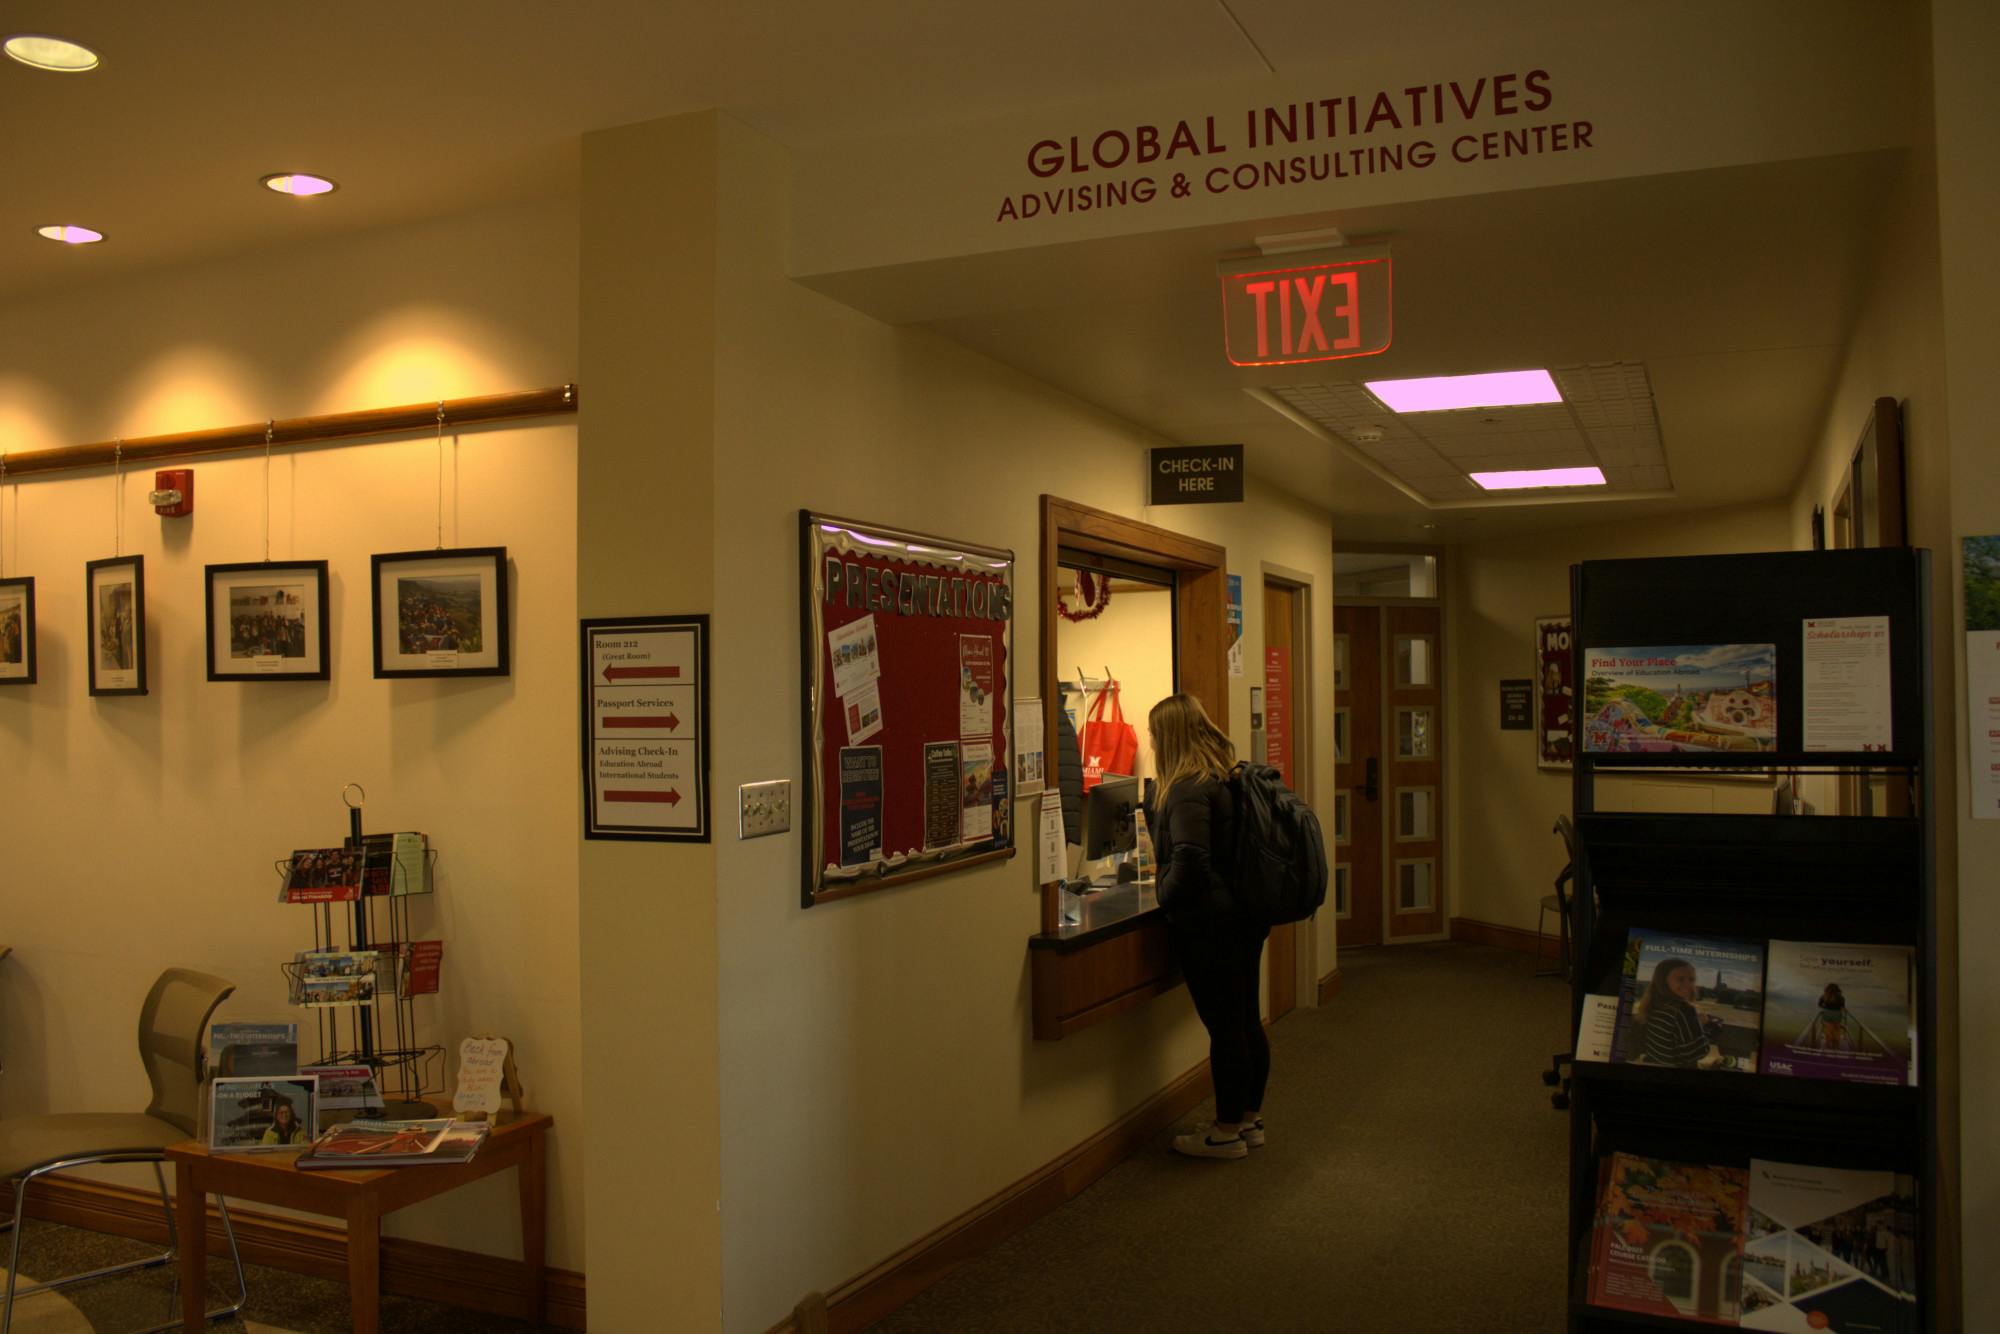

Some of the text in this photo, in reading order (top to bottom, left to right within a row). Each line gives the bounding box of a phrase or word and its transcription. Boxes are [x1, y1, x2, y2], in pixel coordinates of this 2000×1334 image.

[1028, 69, 1553, 179] GLOBAL INITIATIVES
[996, 120, 1595, 223] ADVISING & CONSULTING CENTER
[1159, 456, 1235, 474] CHECK-IN
[1178, 477, 1215, 493] HERE
[826, 556, 1012, 621] PRESENTATIONS
[595, 640, 622, 649] Room
[1592, 656, 1677, 668] Find Your Place
[1635, 669, 1671, 677] Education
[597, 698, 674, 710] Passport Services
[599, 747, 678, 757] Advising Check-In
[599, 760, 662, 768] Education Abroad
[599, 771, 646, 780] International
[1645, 944, 1758, 962] FULL-TIME INTERNSHIPS
